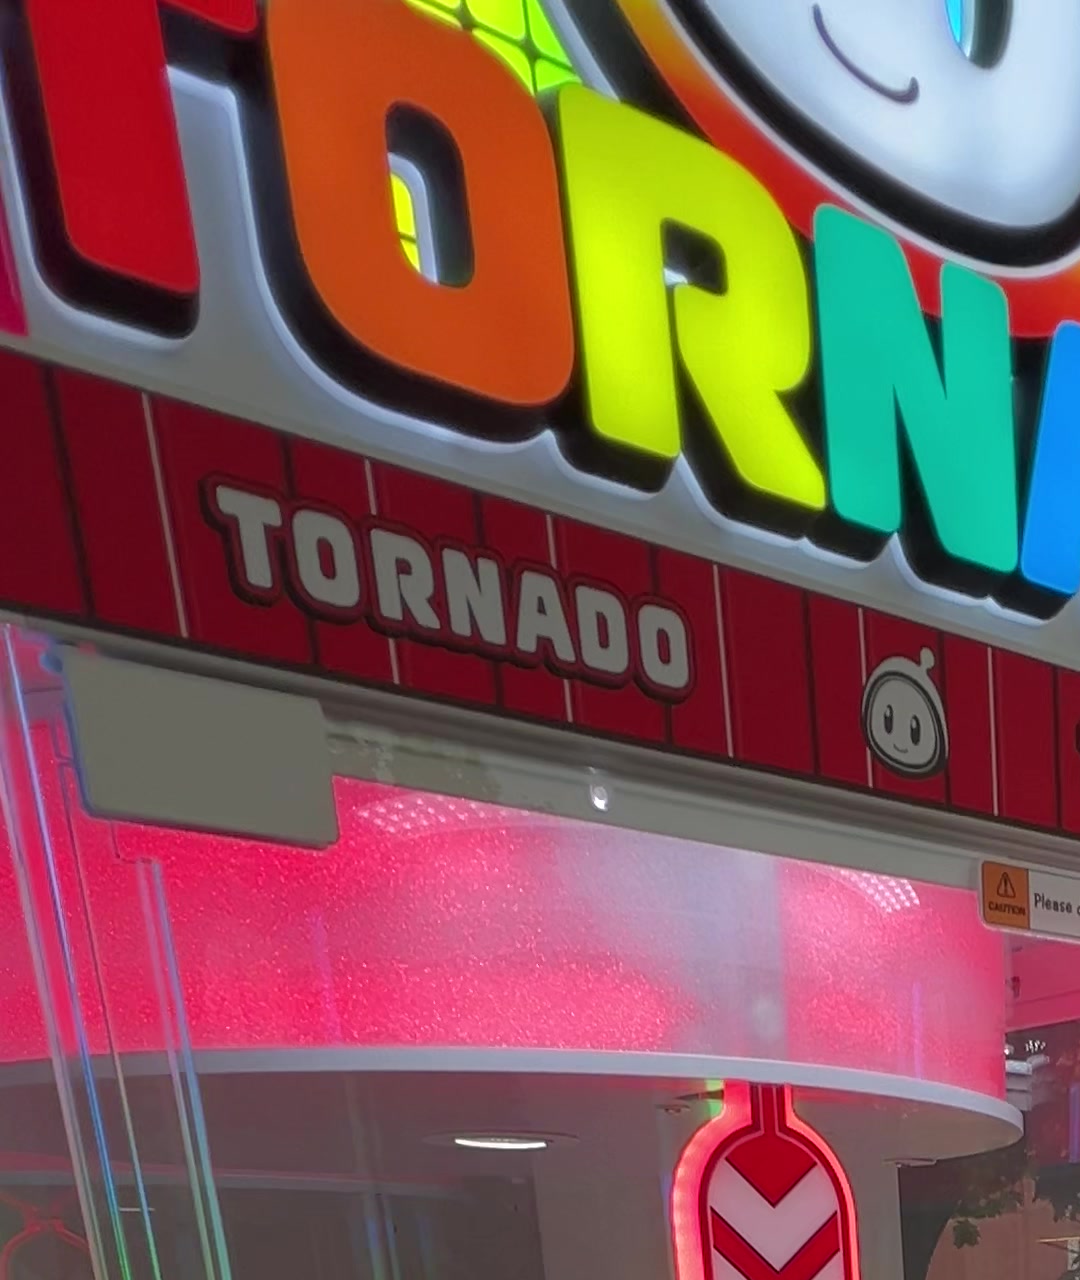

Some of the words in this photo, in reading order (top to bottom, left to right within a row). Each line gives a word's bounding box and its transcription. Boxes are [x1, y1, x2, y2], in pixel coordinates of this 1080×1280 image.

[216, 484, 690, 689] TORNADO
[988, 902, 1026, 917] CAUTION
[1033, 893, 1073, 915] Please
